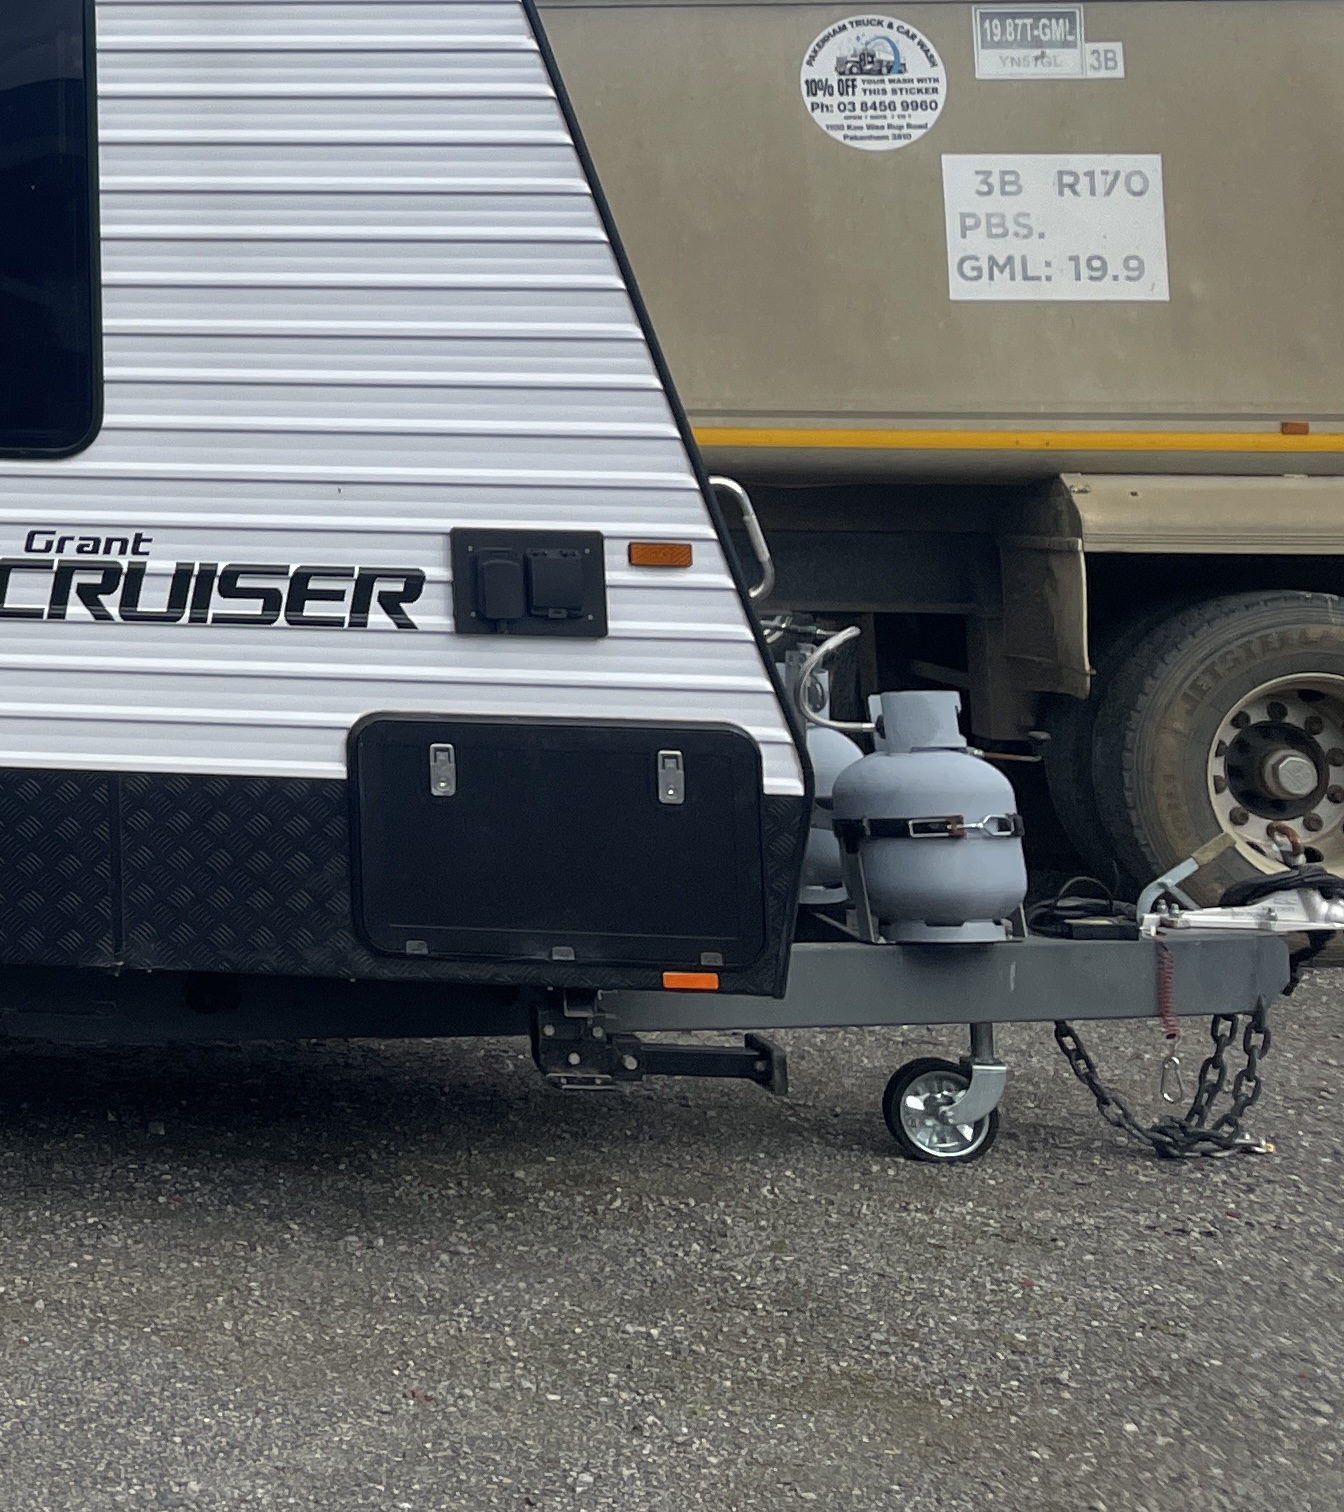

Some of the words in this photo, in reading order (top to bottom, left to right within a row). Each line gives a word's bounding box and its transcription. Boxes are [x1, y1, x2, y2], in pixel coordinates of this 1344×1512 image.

[805, 23, 849, 67] PAKENHAM
[848, 18, 885, 29] TRUCK
[896, 25, 918, 42] CAR
[916, 39, 938, 68] WASH
[1089, 49, 1119, 71] 3B
[804, 77, 834, 98] 10%
[837, 77, 858, 97] OFF
[861, 87, 888, 96] THIS
[890, 86, 939, 96] STICKER
[810, 101, 834, 113] Ph:
[837, 101, 857, 113] 03
[900, 99, 939, 112] 9960
[974, 169, 1024, 198] 3B
[1056, 169, 1150, 198] R170
[958, 211, 1046, 240] PBS.
[956, 254, 1053, 283] GML:
[1068, 254, 1146, 283] 19.9
[23, 529, 154, 557] Grant
